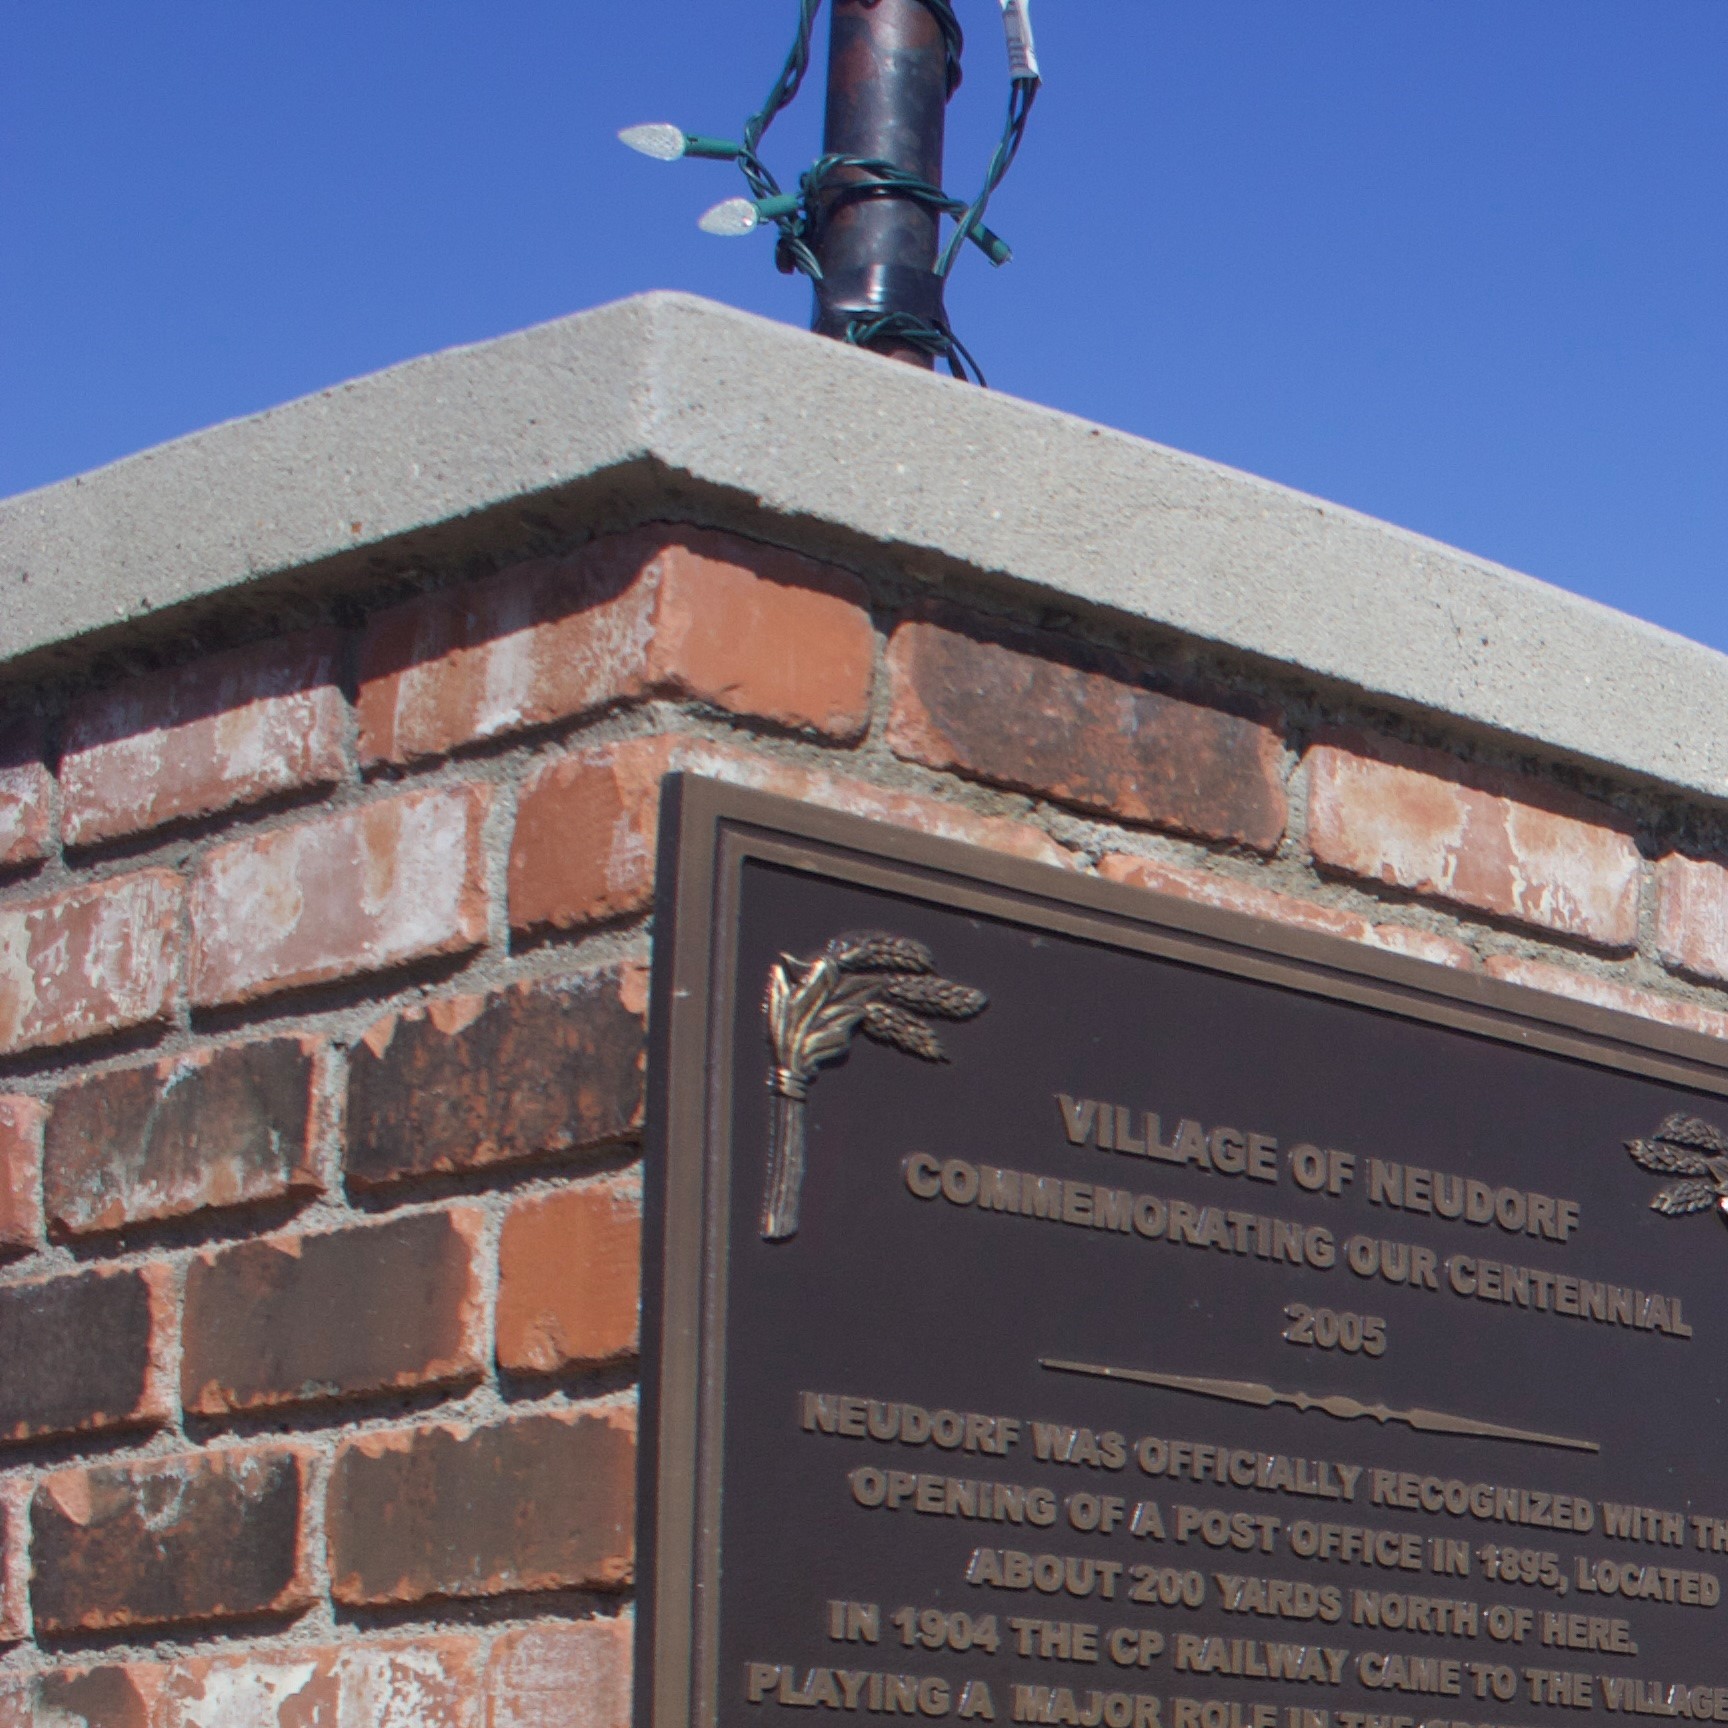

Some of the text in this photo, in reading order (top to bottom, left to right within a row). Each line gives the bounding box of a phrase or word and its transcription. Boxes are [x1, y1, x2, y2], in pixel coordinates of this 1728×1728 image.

[1055, 1092, 1580, 1241] VILLAGE OF NEUDORF
[904, 1153, 1693, 1338] COMMEMORATING OUR CENTENNIAL
[1285, 1303, 1386, 1354] 2005
[801, 1392, 1019, 1455] NEUDORF
[1029, 1421, 1127, 1469] WAS
[1135, 1437, 1363, 1501] OFFICIALLY
[1369, 1468, 1594, 1534] RECOGNIZED
[1601, 1502, 1685, 1545] WITH
[849, 1467, 1720, 1608] OPENING OF A POST OFFICE IN 1895, LOCATED
[828, 1601, 879, 1643] IN
[892, 1606, 1000, 1654] 1904
[1009, 1617, 1099, 1661] THE
[1108, 1629, 1165, 1667] CP
[1176, 1635, 1348, 1685] RAILWAY
[1356, 1652, 1461, 1697] CAME
[1467, 1664, 1516, 1701] TO
[1522, 1670, 1592, 1708] THE
[966, 1548, 1638, 1656] ABOUT 200 YARDS NORTH OF HERE.
[747, 1663, 950, 1717] PLAYING
[959, 1682, 994, 1719] A
